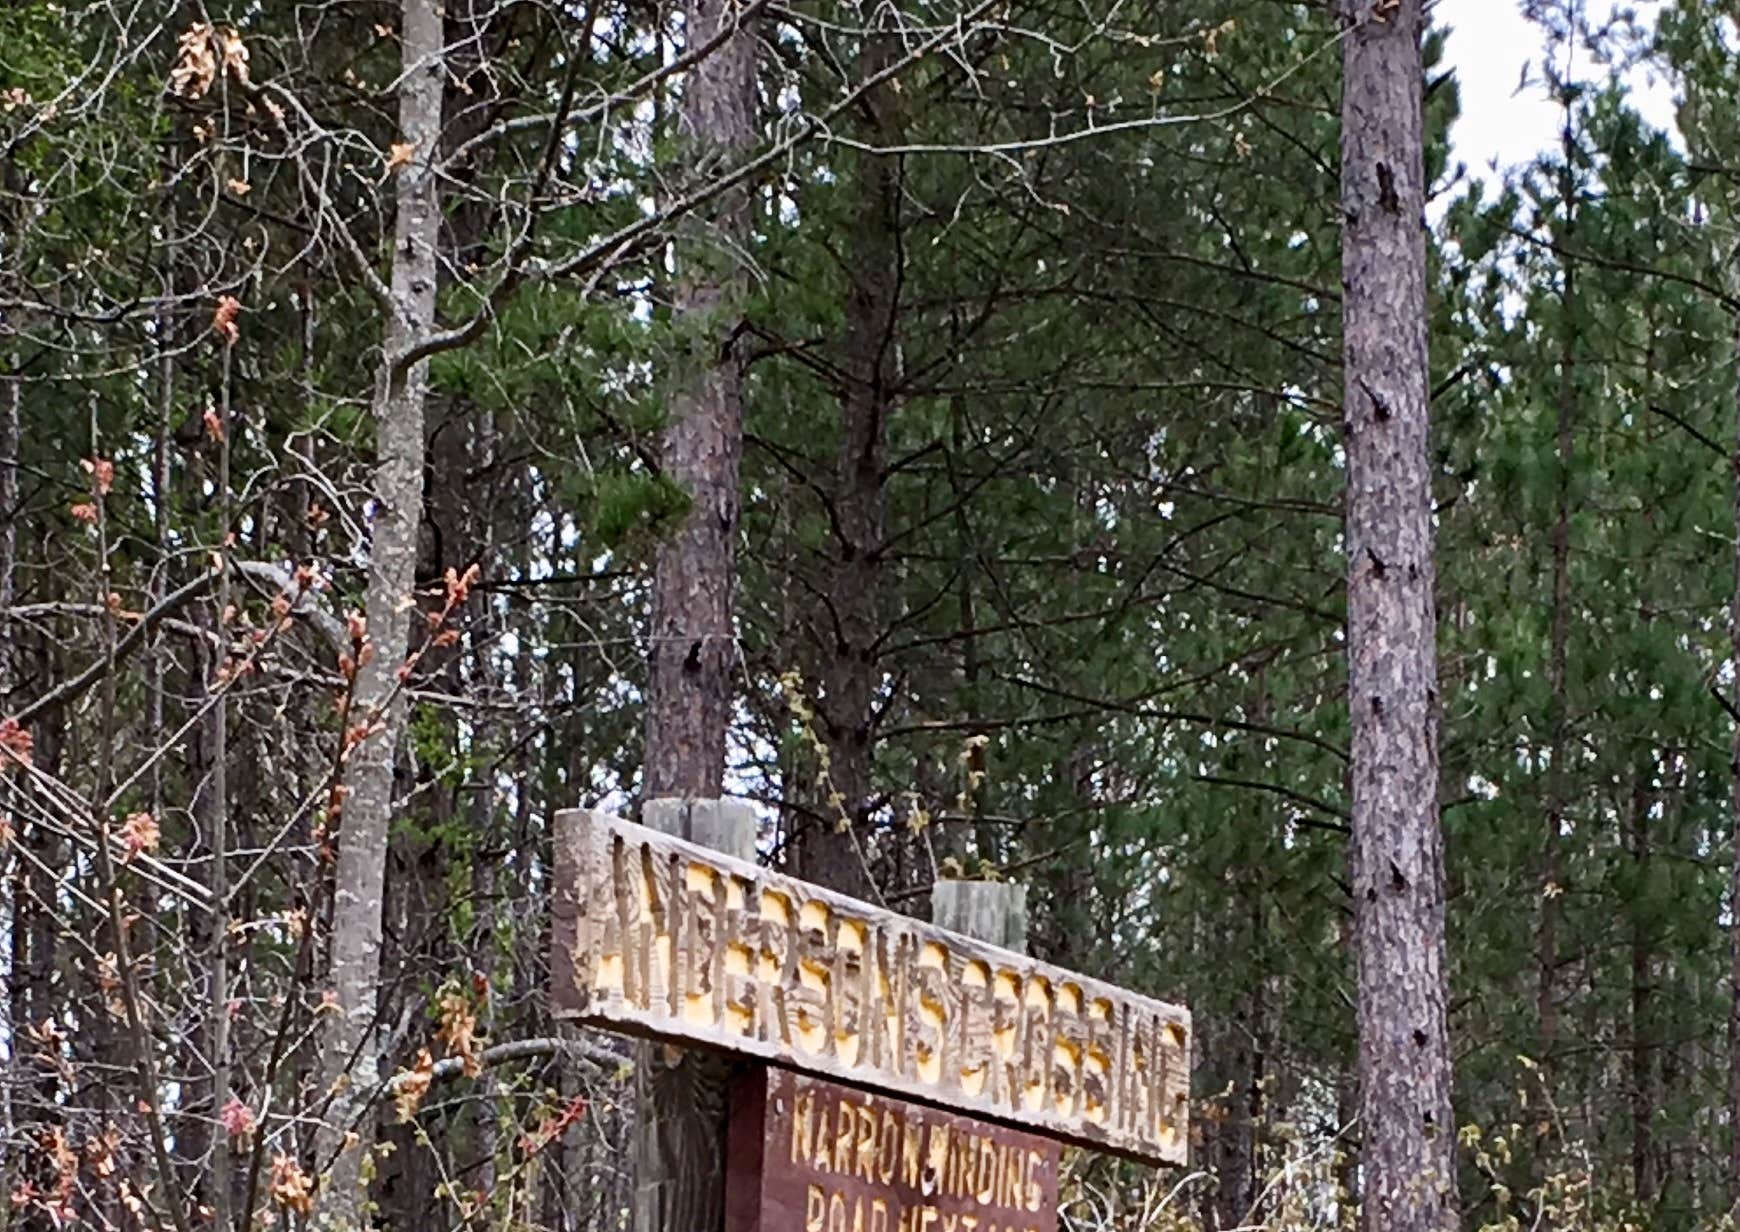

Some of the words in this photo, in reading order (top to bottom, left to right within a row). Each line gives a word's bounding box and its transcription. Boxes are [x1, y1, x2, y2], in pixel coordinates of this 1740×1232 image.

[959, 957, 1187, 1146] CROSSING
[791, 1093, 924, 1190] NARROW
[930, 1122, 1044, 1213] WINDING
